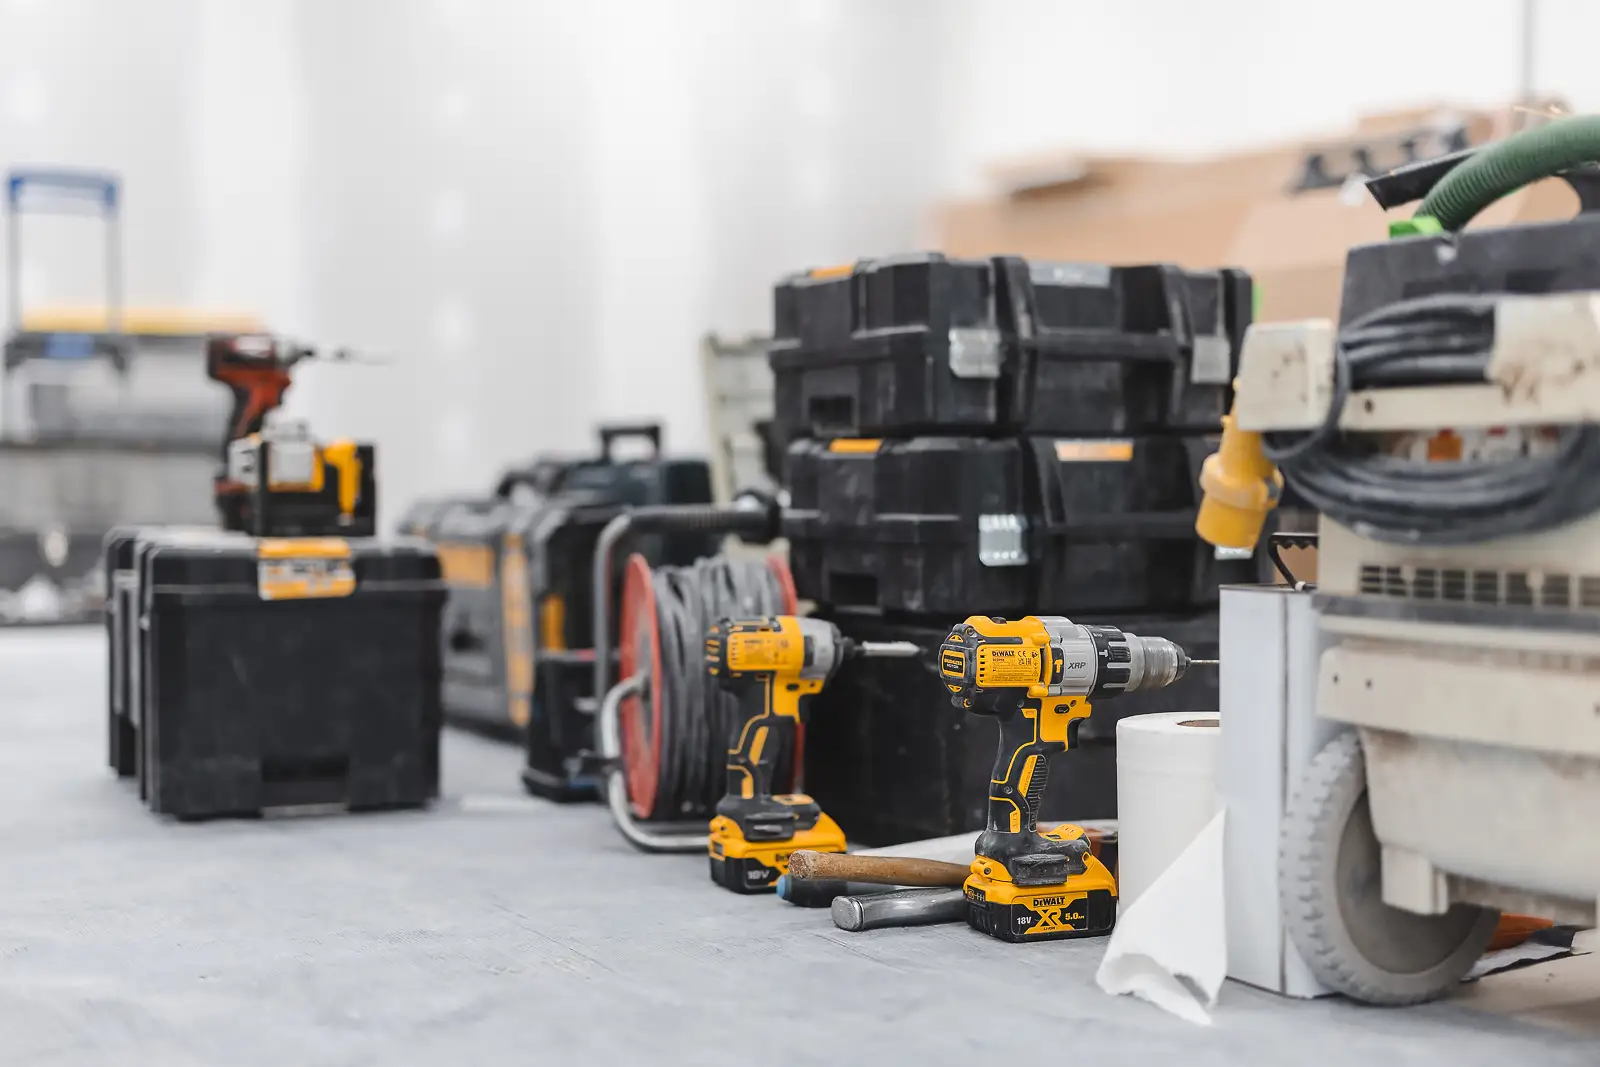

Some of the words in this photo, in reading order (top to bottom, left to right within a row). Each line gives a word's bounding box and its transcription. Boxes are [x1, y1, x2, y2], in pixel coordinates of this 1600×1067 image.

[1067, 661, 1086, 670] XRP
[1016, 916, 1032, 925] 18V
[1035, 908, 1063, 927] XR
